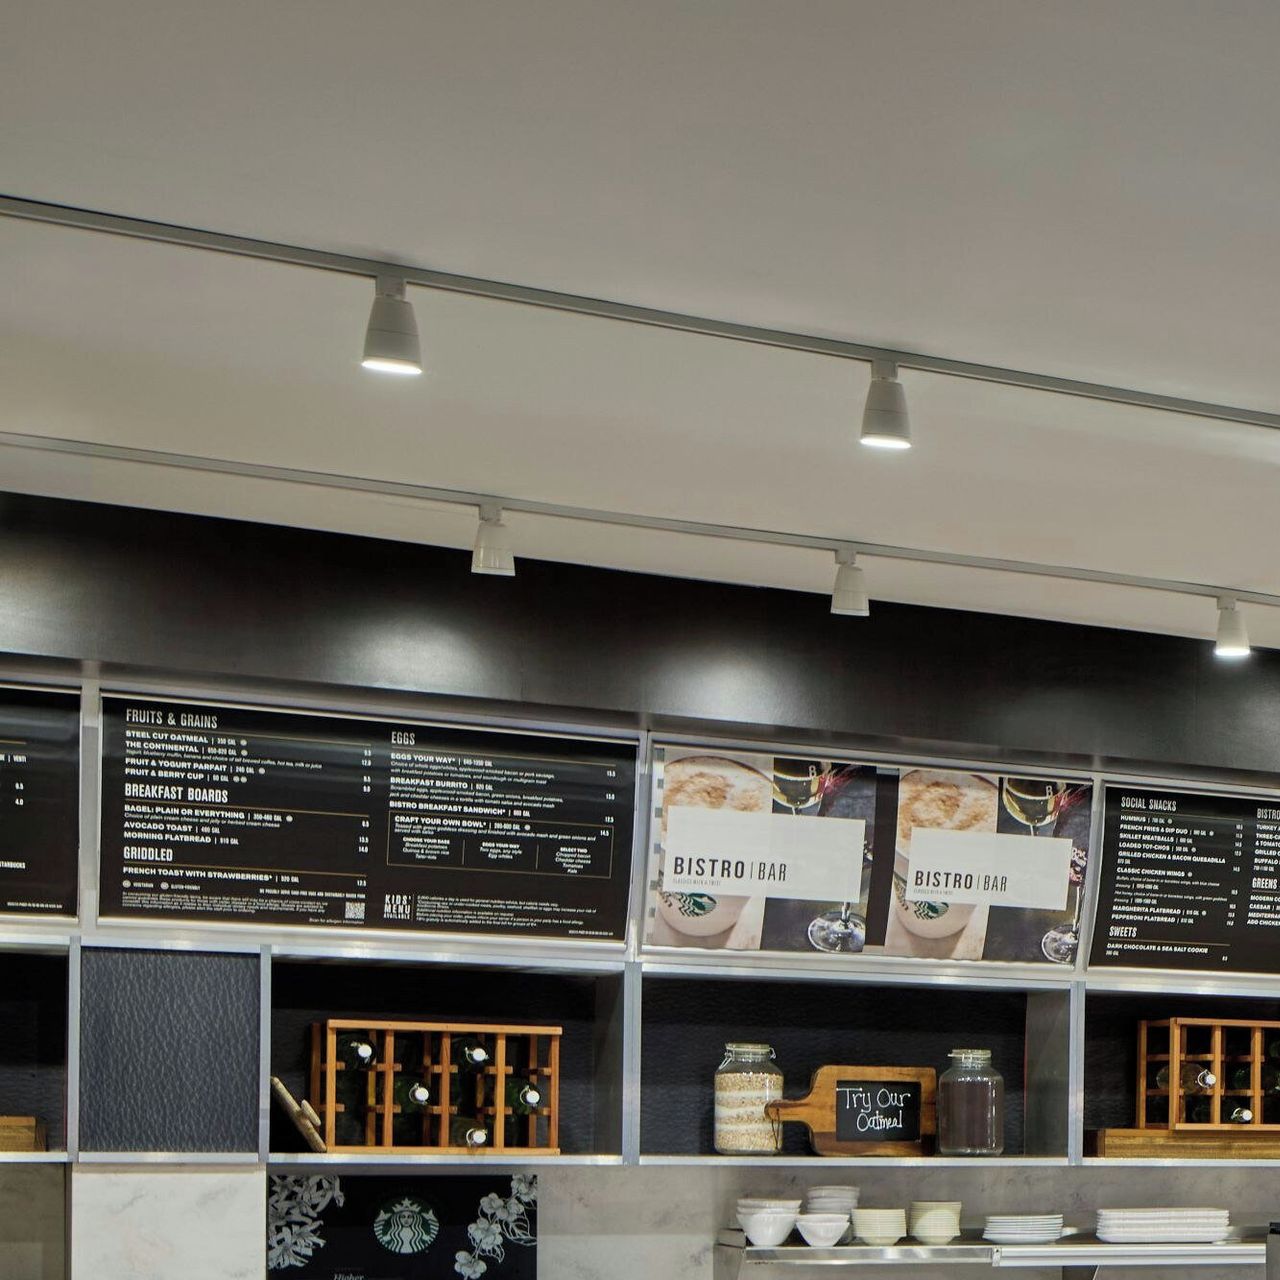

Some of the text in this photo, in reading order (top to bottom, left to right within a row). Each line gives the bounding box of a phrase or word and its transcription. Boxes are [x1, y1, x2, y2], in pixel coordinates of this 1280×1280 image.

[126, 708, 218, 729] FRUITS & GRAINS
[125, 730, 209, 744] STEEL CUT OATMEAL
[391, 731, 416, 746] EGGS
[125, 740, 199, 753] THE CONTINENTAL
[391, 752, 412, 762] EGGS
[412, 754, 434, 763] YOUR
[125, 757, 149, 767] FRUIT
[158, 759, 192, 770] YOGURT
[193, 762, 227, 772] PARFAIT
[124, 767, 149, 777] FRUIT
[158, 769, 185, 779] BERRY
[186, 771, 205, 780] CUP
[390, 776, 469, 789] BREAKFAST BURRITO
[124, 782, 229, 804] BREAKFAST BOARDS
[389, 800, 417, 810] BISTRO
[418, 802, 462, 813] BREAKFAST
[1120, 796, 1177, 812] SOCIAL SNACKS
[155, 806, 180, 815] PLAIN
[181, 808, 193, 816] OR
[194, 808, 245, 820] EVERYTHING
[124, 821, 193, 833] AVOCADO TOAST
[394, 815, 420, 825] CRAFT
[420, 816, 442, 826] YOUR
[442, 818, 461, 827] OWN
[123, 831, 212, 844] MORNING FLATBREAD
[123, 846, 173, 862] GRIDDLED
[123, 866, 156, 876] FRENCH
[157, 868, 184, 877] TOAST
[185, 869, 206, 879] WITH
[674, 856, 787, 882] BISTRO BAR
[915, 870, 1007, 892] BISTRO BAR
[1252, 877, 1278, 890] GREENS
[384, 904, 411, 914] MENU
[1109, 926, 1138, 938] SWEETS
[836, 1088, 911, 1113] Try Our
[856, 1110, 903, 1132] Oatmeal
